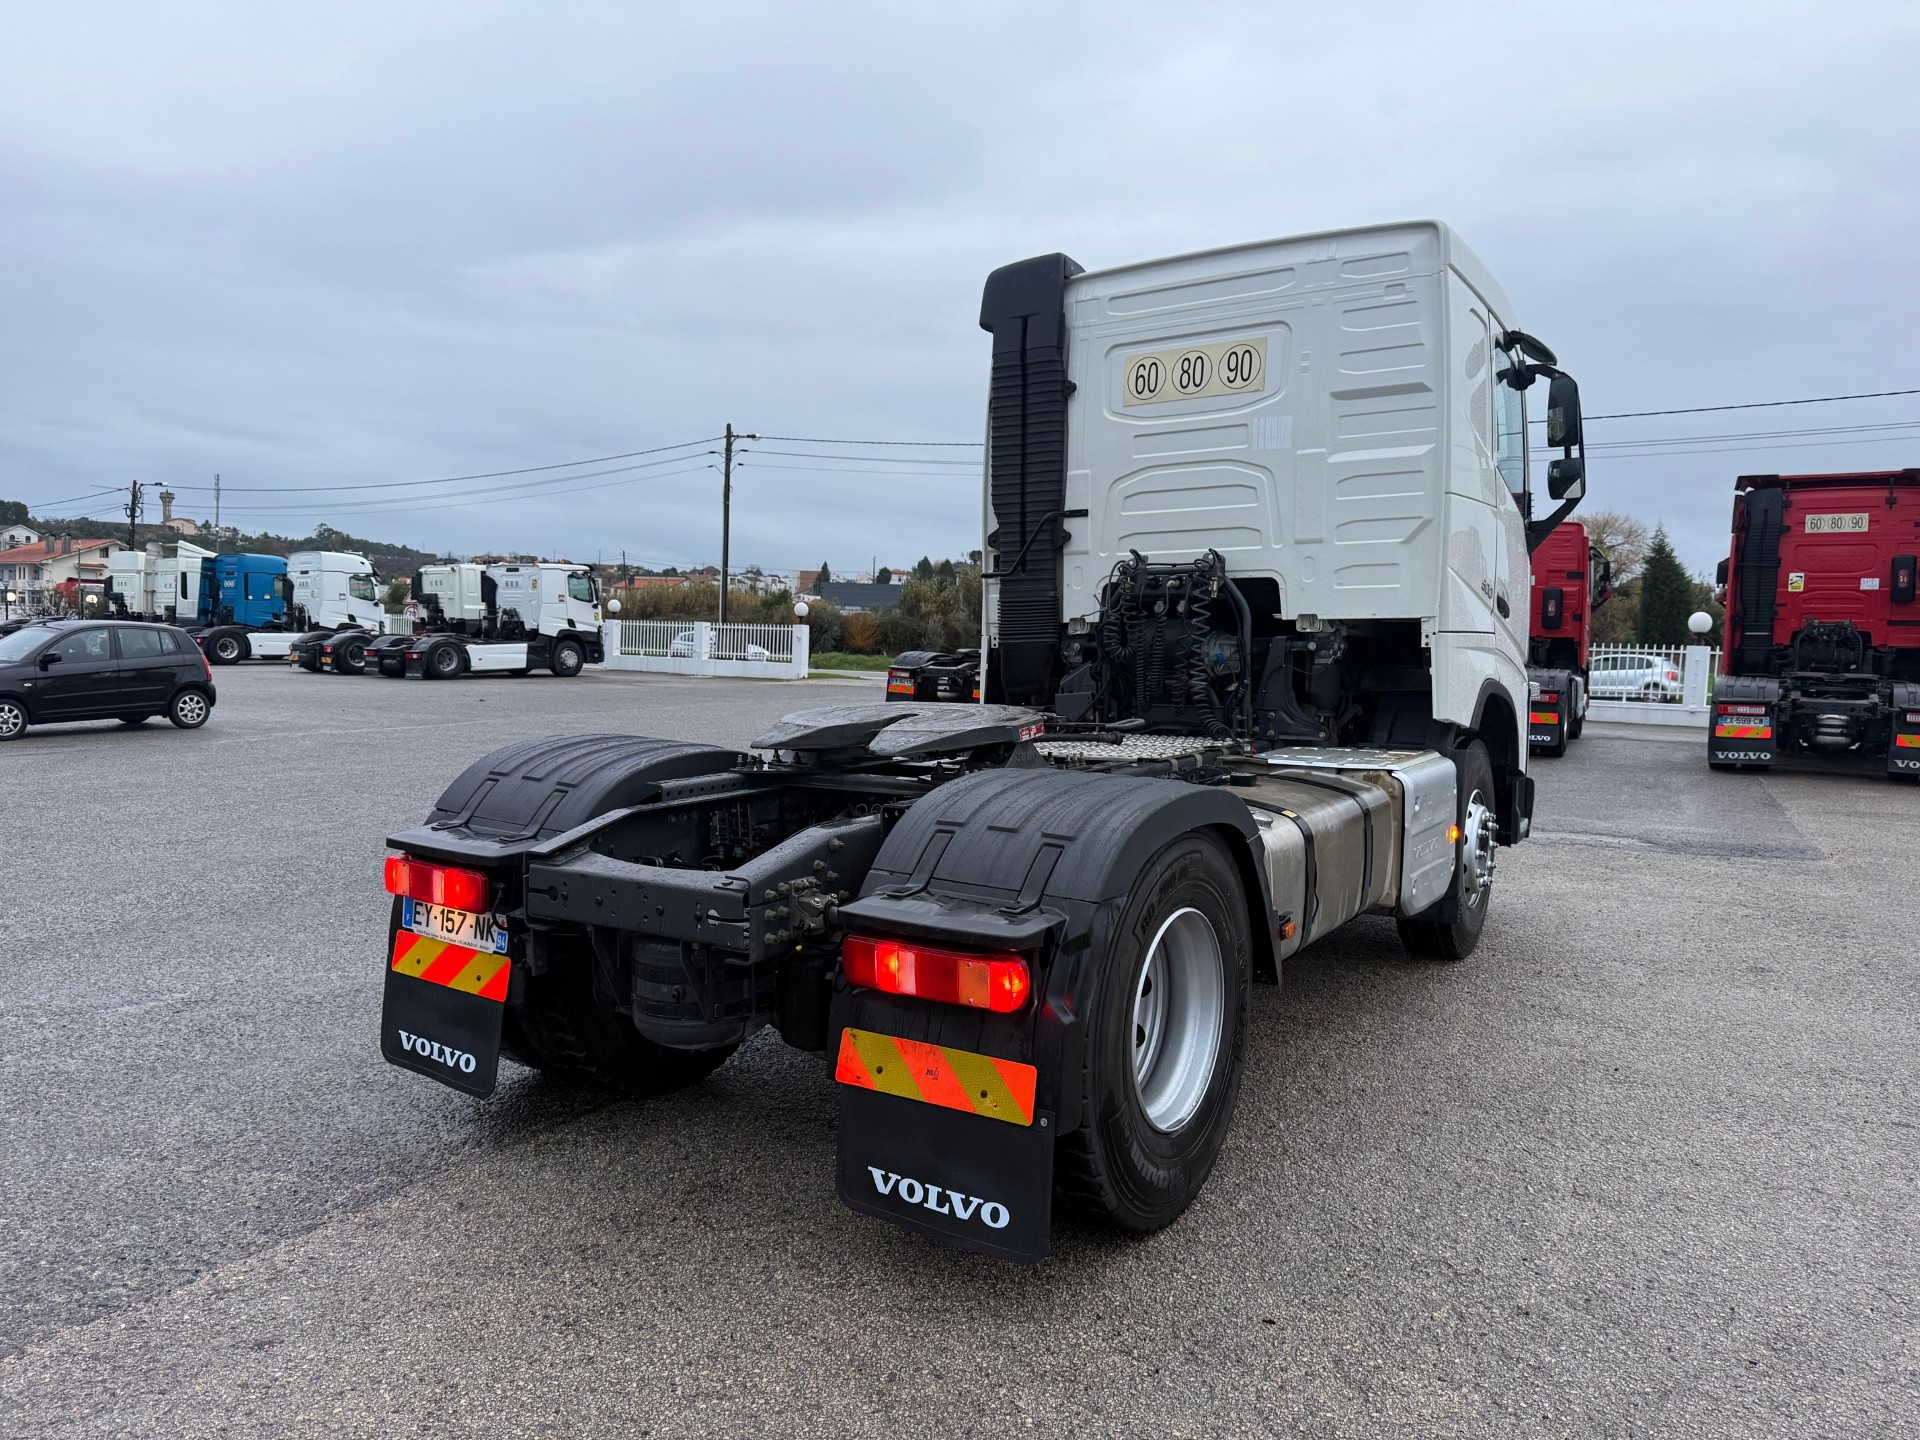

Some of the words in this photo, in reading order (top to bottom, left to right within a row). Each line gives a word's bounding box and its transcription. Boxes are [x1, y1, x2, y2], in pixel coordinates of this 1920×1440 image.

[1135, 361, 1159, 395] 60
[1179, 355, 1205, 389] 80
[1226, 349, 1253, 384] 90
[1810, 518, 1822, 530] 60
[1830, 517, 1843, 529] 80
[1851, 516, 1864, 529] 90
[1528, 734, 1551, 742] LVO
[1714, 750, 1772, 760] VOLVO
[398, 1029, 477, 1074] VOLVO
[867, 1165, 1011, 1229] VOLVO
